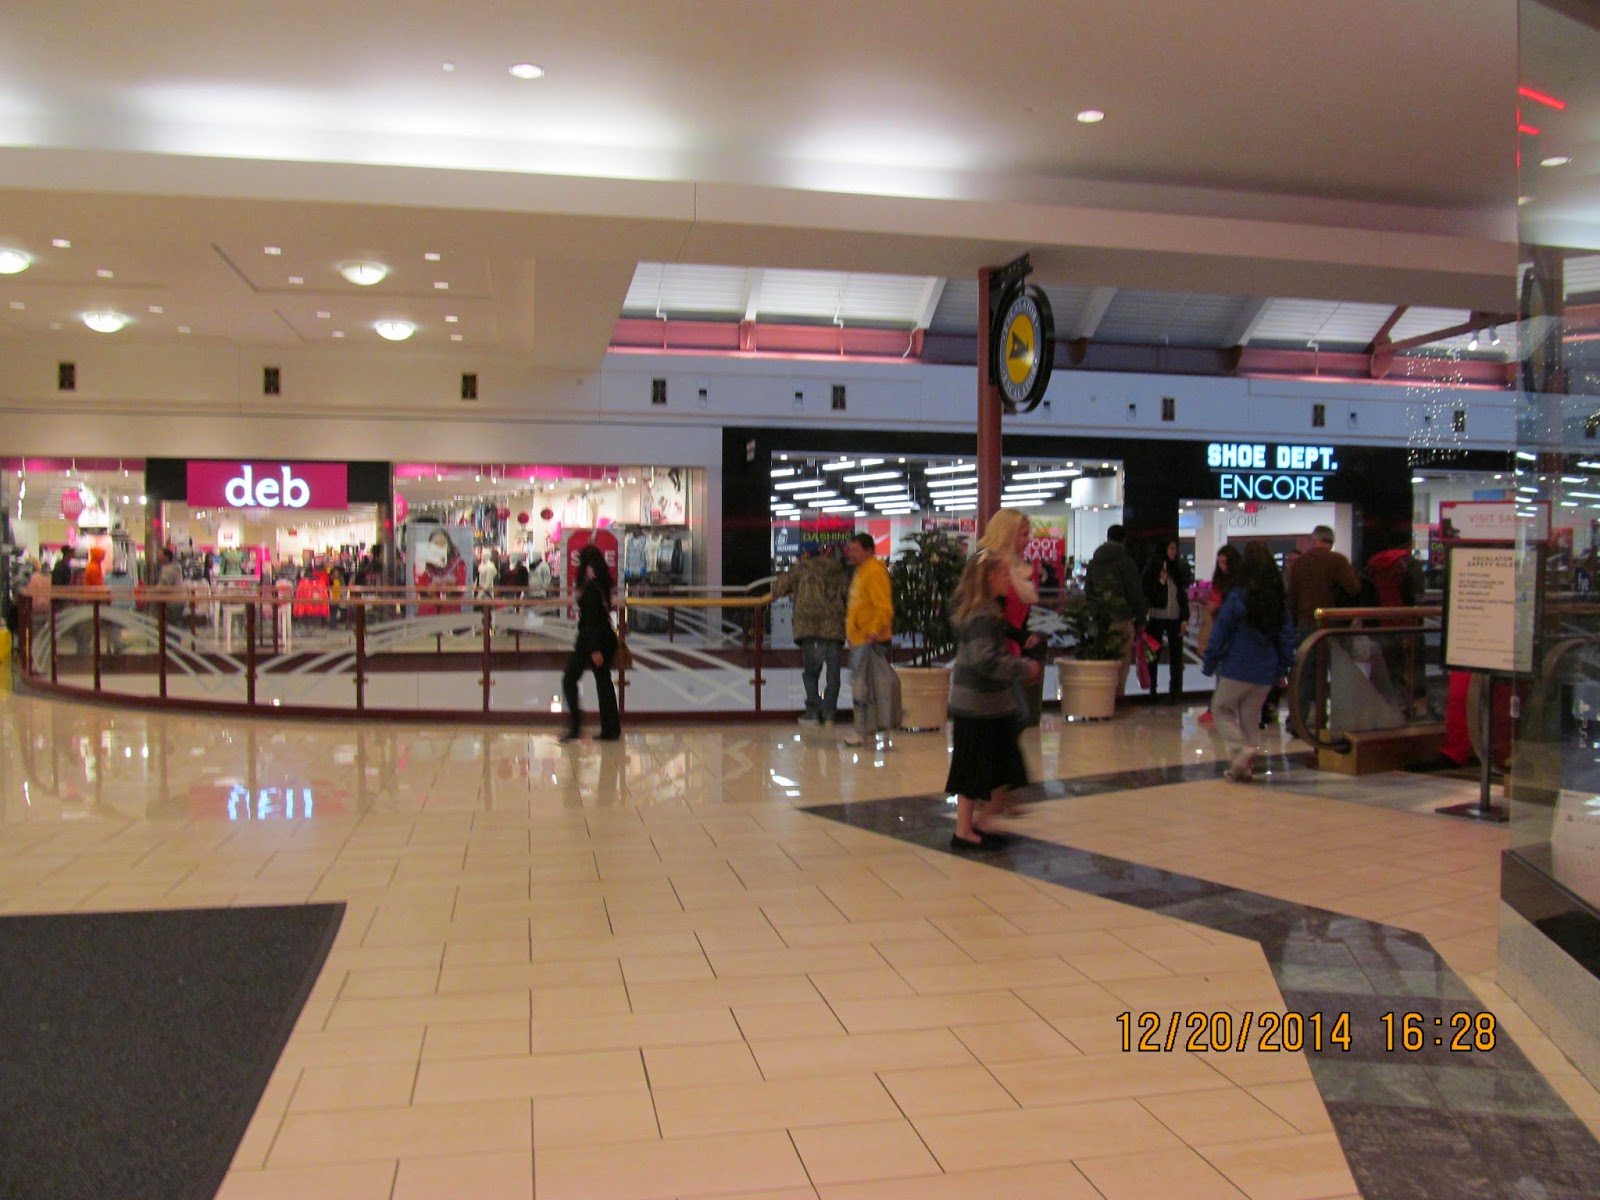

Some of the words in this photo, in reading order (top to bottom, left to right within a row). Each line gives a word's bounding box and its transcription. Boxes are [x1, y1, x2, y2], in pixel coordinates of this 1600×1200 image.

[1207, 443, 1266, 468] SHOE
[1276, 445, 1339, 470] DEPT.
[225, 464, 310, 508] deb
[1220, 474, 1324, 500] ENCORE
[571, 550, 616, 567] SE
